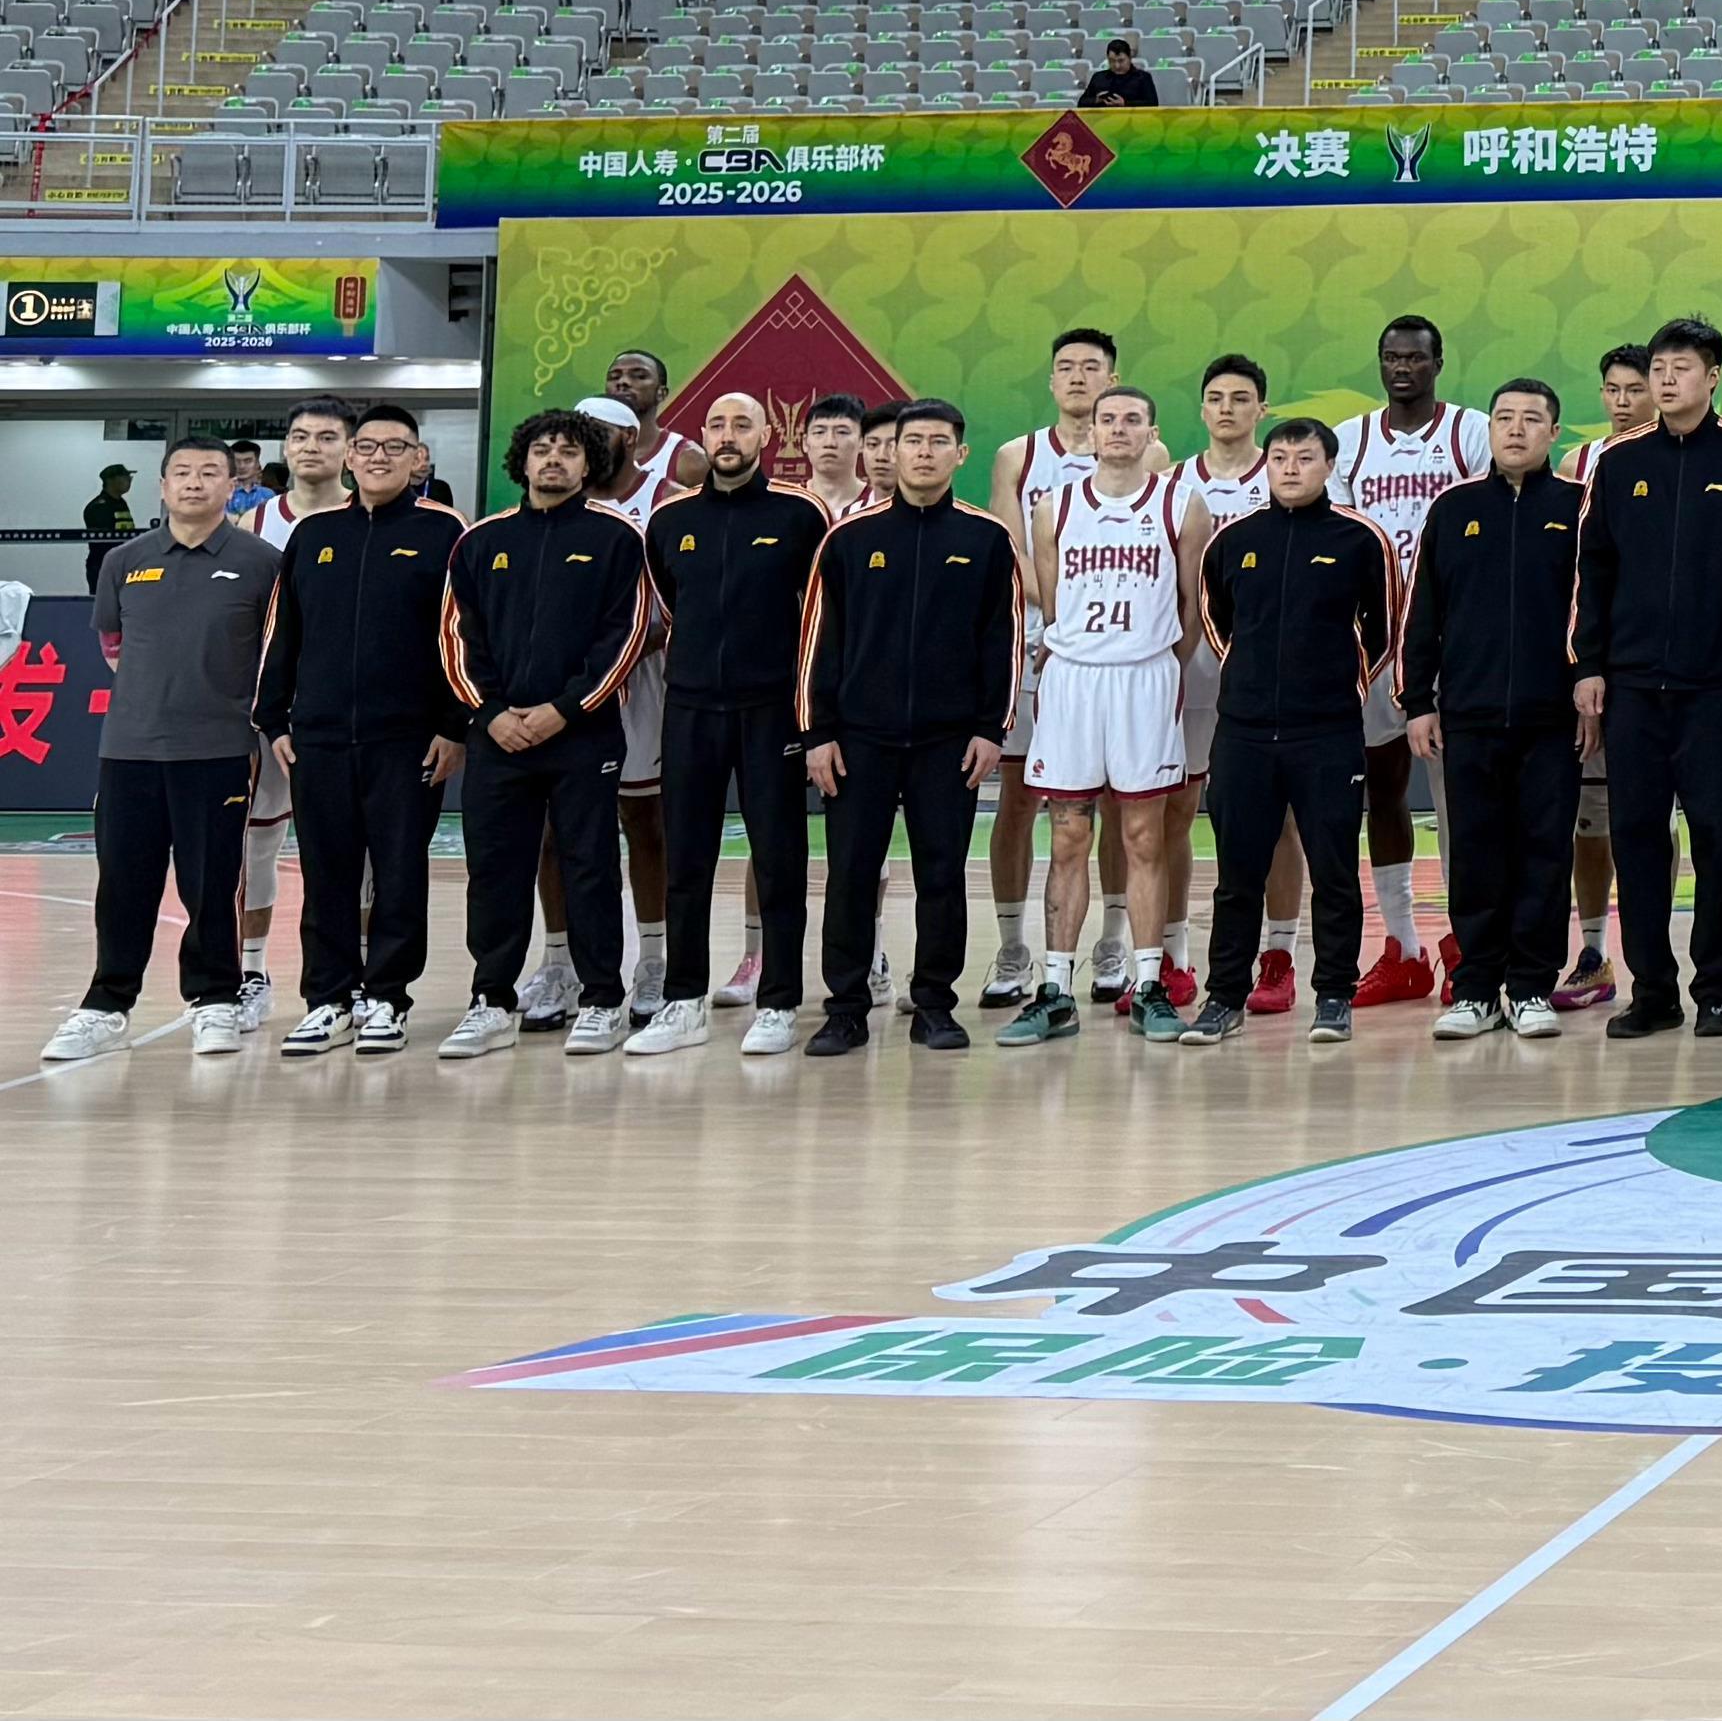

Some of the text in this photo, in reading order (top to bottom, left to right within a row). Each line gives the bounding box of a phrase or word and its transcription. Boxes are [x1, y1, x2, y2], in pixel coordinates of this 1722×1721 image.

[706, 125, 760, 145] 第二届
[1253, 123, 1658, 179] 决赛 呼和浩特
[658, 181, 802, 206] 2025-2026
[1064, 544, 1161, 582] SHANXI
[1083, 600, 1132, 633] 24
